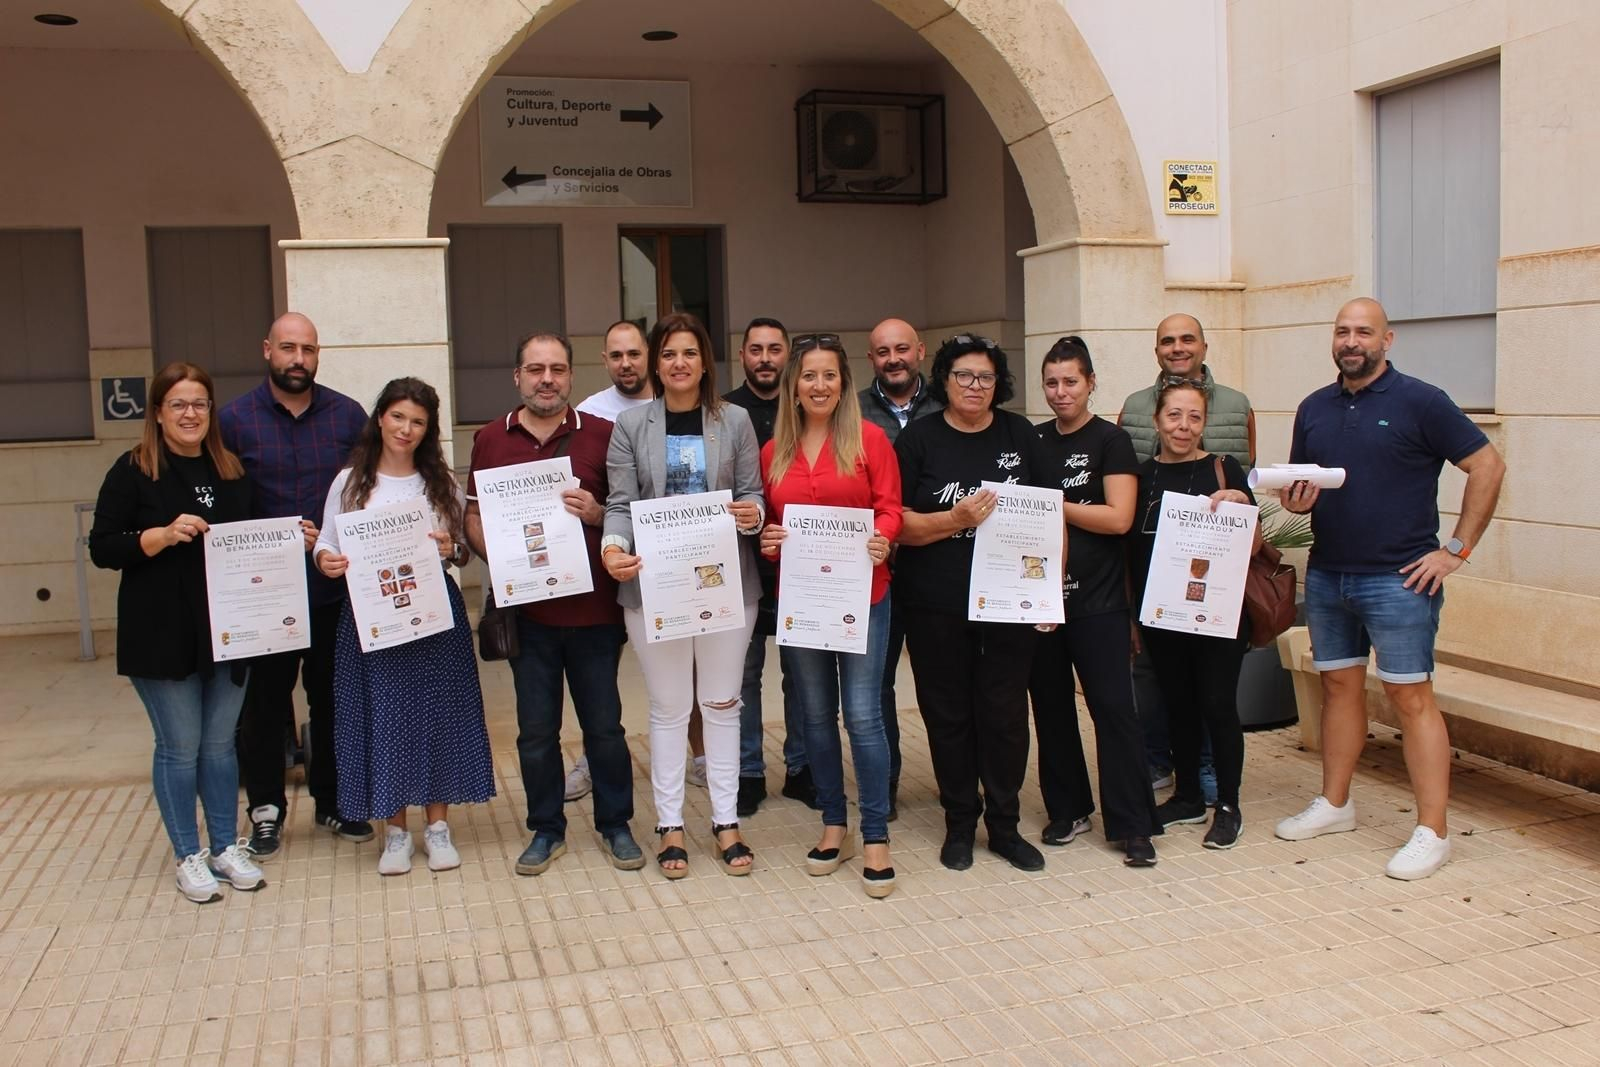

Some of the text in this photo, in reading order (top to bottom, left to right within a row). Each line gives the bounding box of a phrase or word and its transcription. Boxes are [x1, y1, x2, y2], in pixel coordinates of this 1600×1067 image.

[506, 88, 555, 97] Promoción:
[507, 98, 611, 112] Cultura, Deporte
[507, 116, 578, 128] y Juventud
[552, 166, 672, 179] Concejalia de Obras
[553, 183, 619, 194] y Servicios
[1169, 202, 1215, 210] PROSEGUR
[499, 485, 554, 498] BENAHADUX
[997, 495, 1058, 513] STRONOMICA
[998, 507, 1047, 517] BENAHADUX
[655, 518, 713, 530] BENAHADUX
[1179, 521, 1233, 533] BENAHADUX
[359, 524, 414, 541] BENAHADUX
[802, 530, 856, 539] BENAHADUX
[226, 543, 282, 552] BENAHADUX
